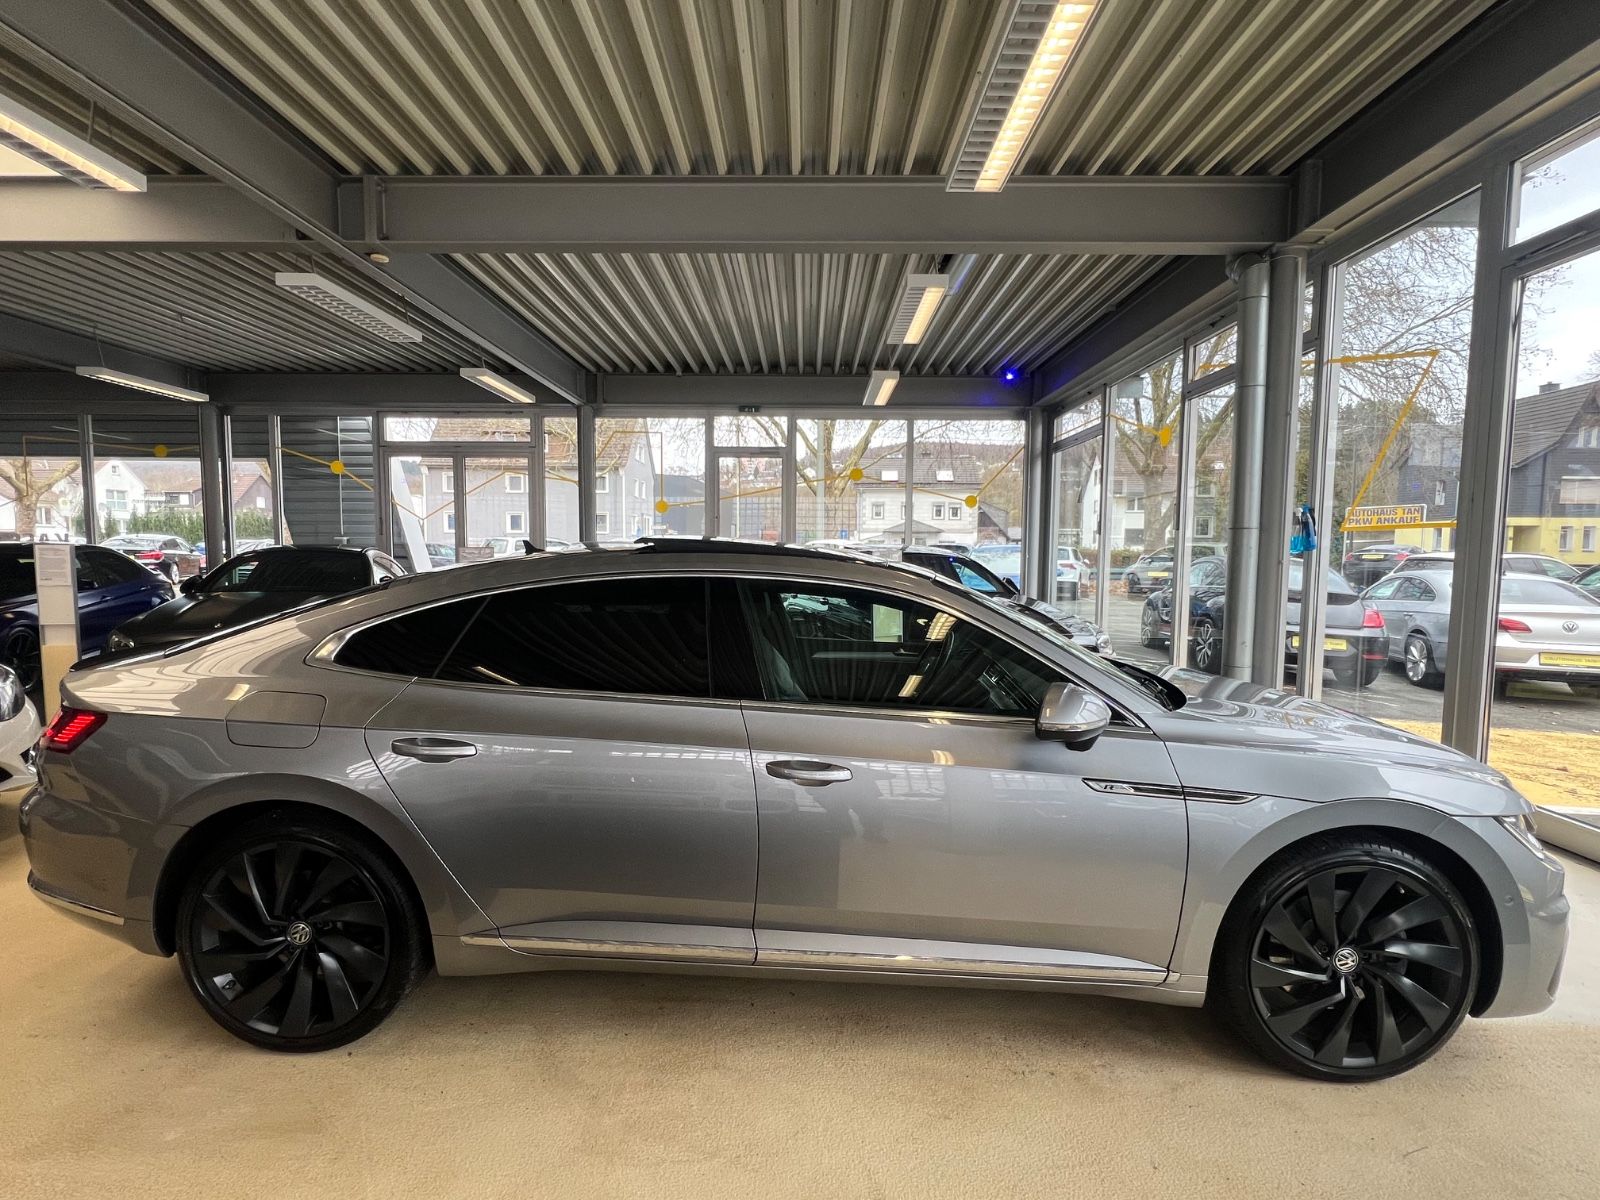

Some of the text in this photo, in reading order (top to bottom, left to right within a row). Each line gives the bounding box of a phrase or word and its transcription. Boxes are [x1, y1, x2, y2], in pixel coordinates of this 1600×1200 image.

[1402, 506, 1420, 516] TAN
[1348, 516, 1420, 526] PKW ANKAUF
